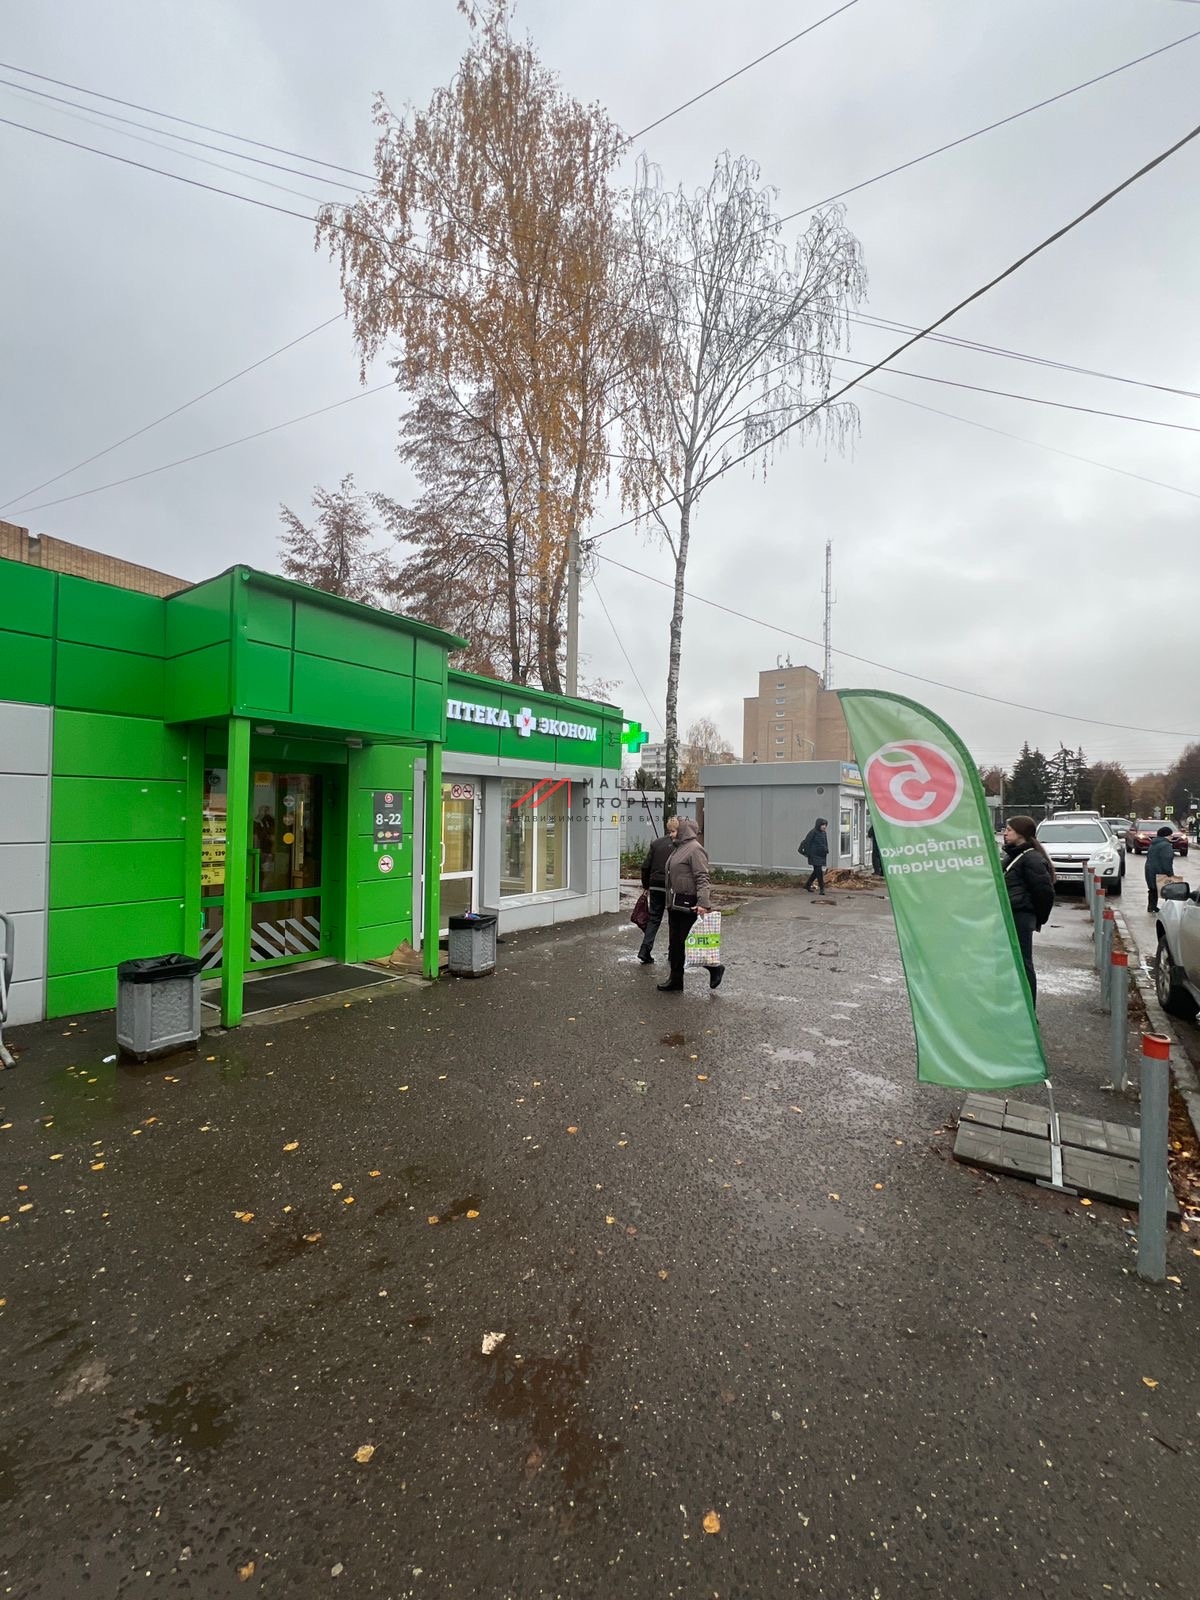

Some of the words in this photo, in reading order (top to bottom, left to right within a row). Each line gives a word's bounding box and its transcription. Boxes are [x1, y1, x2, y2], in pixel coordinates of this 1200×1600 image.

[446, 699, 511, 728] ПТЕКА
[538, 717, 597, 742] ЭКОНОМ
[375, 813, 402, 826] 8-22
